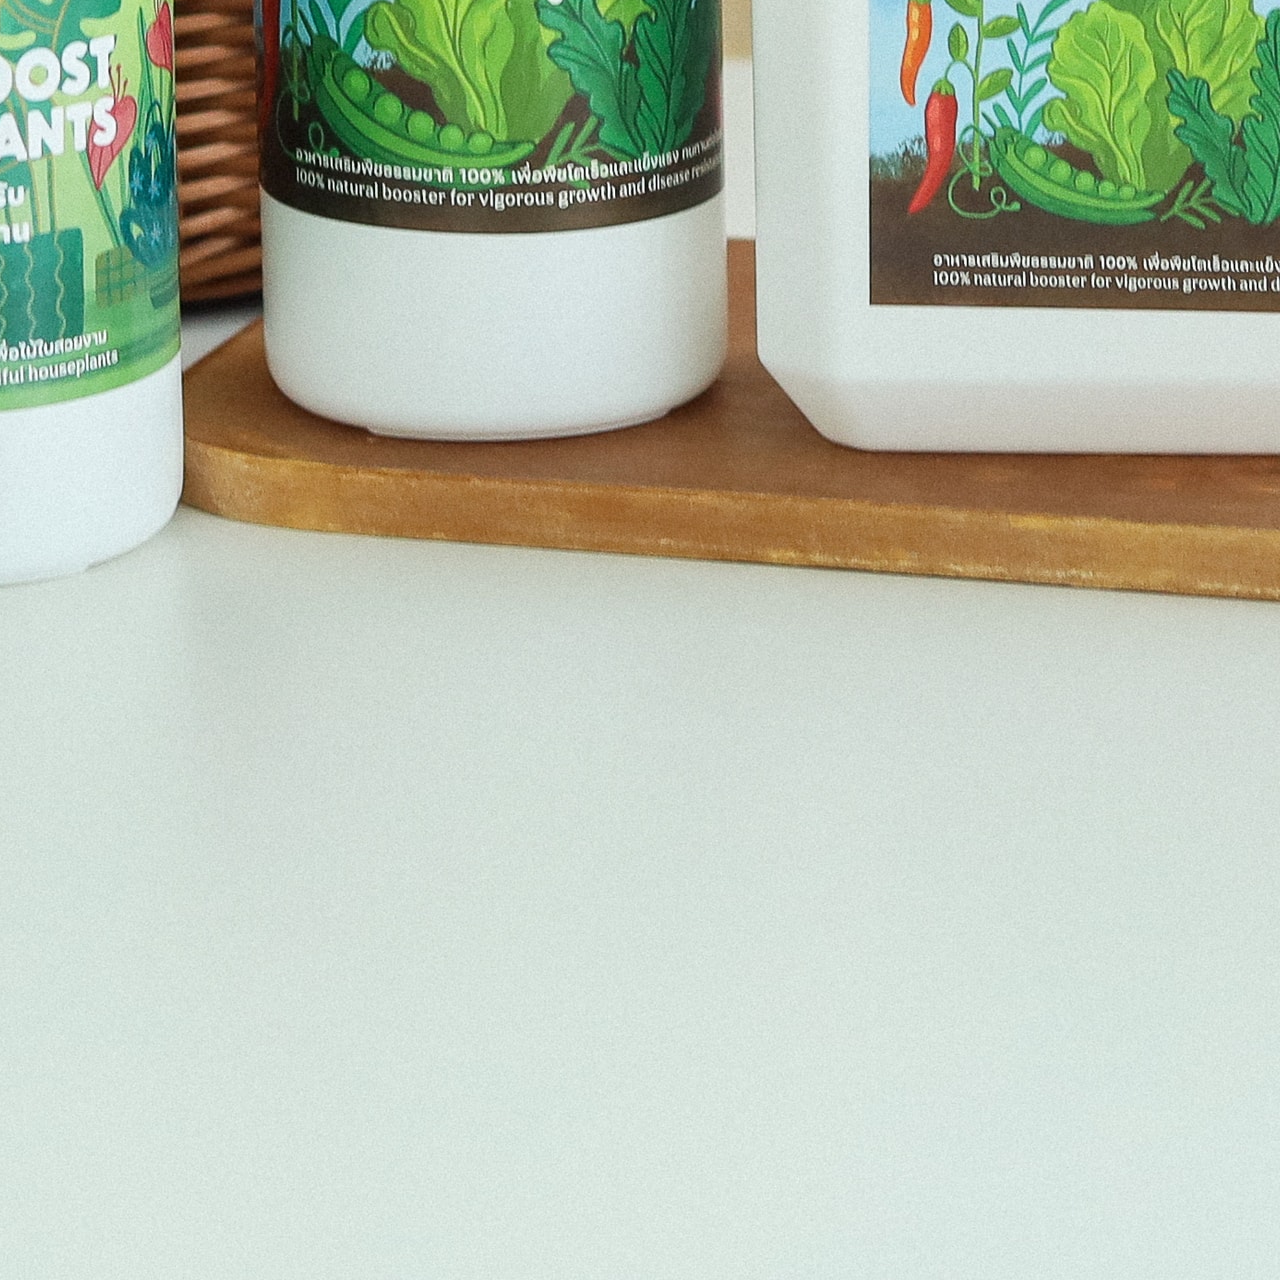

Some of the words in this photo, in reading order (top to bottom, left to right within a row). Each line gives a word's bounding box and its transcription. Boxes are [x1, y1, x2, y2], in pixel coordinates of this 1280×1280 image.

[459, 168, 505, 185] 100%
[296, 167, 324, 189] 100%
[327, 178, 378, 199] natural
[382, 184, 446, 205] booster
[450, 188, 475, 206] for
[479, 189, 554, 211] vigorous
[558, 182, 616, 209] growth
[619, 177, 645, 193] and
[648, 169, 690, 192] disease
[1099, 255, 1138, 270] 100%
[933, 270, 970, 286] 100%
[974, 271, 1026, 287] natural
[1030, 272, 1087, 288] booster
[1091, 273, 1112, 289] for
[1115, 274, 1179, 293] vigorous
[1183, 276, 1236, 294] growth
[1240, 276, 1267, 292] and
[29, 349, 119, 378] houseplants
